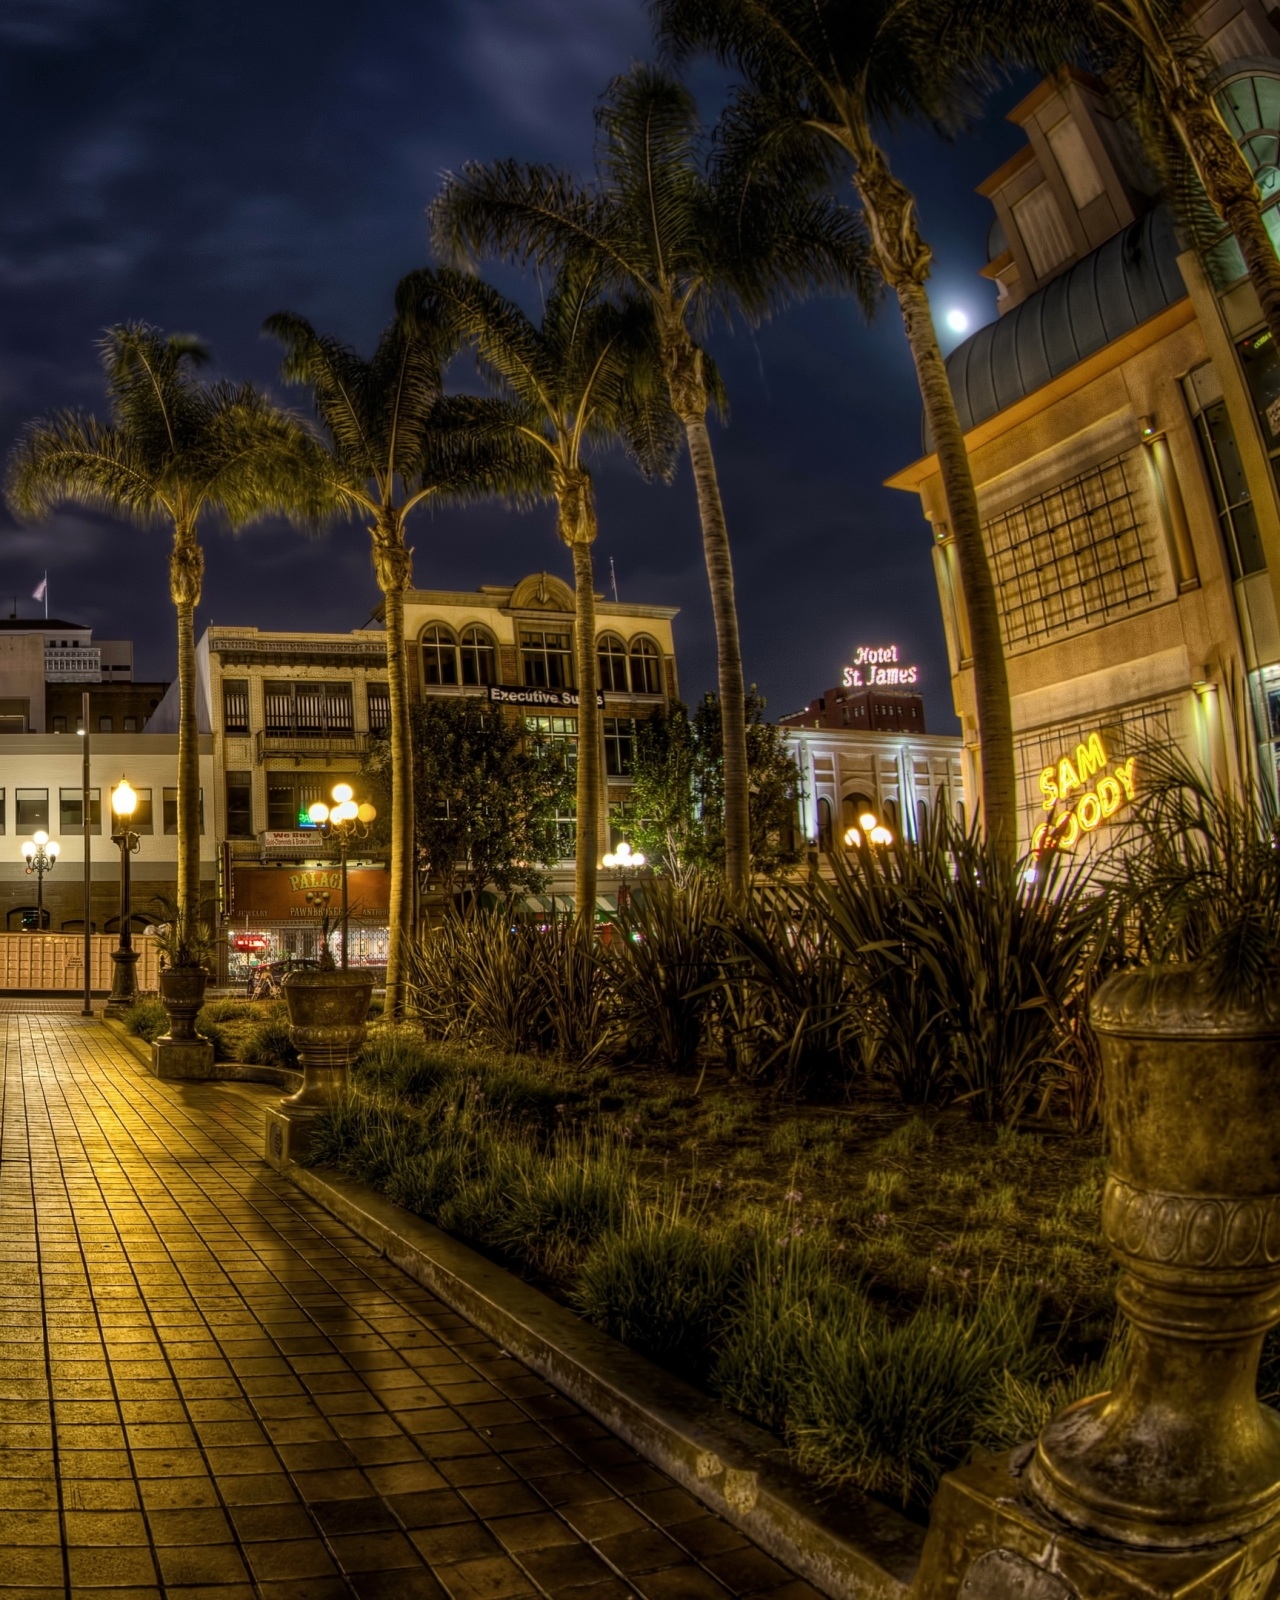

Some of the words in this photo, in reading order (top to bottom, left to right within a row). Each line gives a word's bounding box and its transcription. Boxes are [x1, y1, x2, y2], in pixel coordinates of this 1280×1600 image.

[853, 645, 898, 665] Hotel
[842, 667, 863, 687] St.
[865, 665, 917, 686] James
[490, 687, 559, 705] Executive
[561, 692, 603, 706] Sus
[1039, 732, 1108, 811] SAM
[236, 909, 268, 917] JEWELRY
